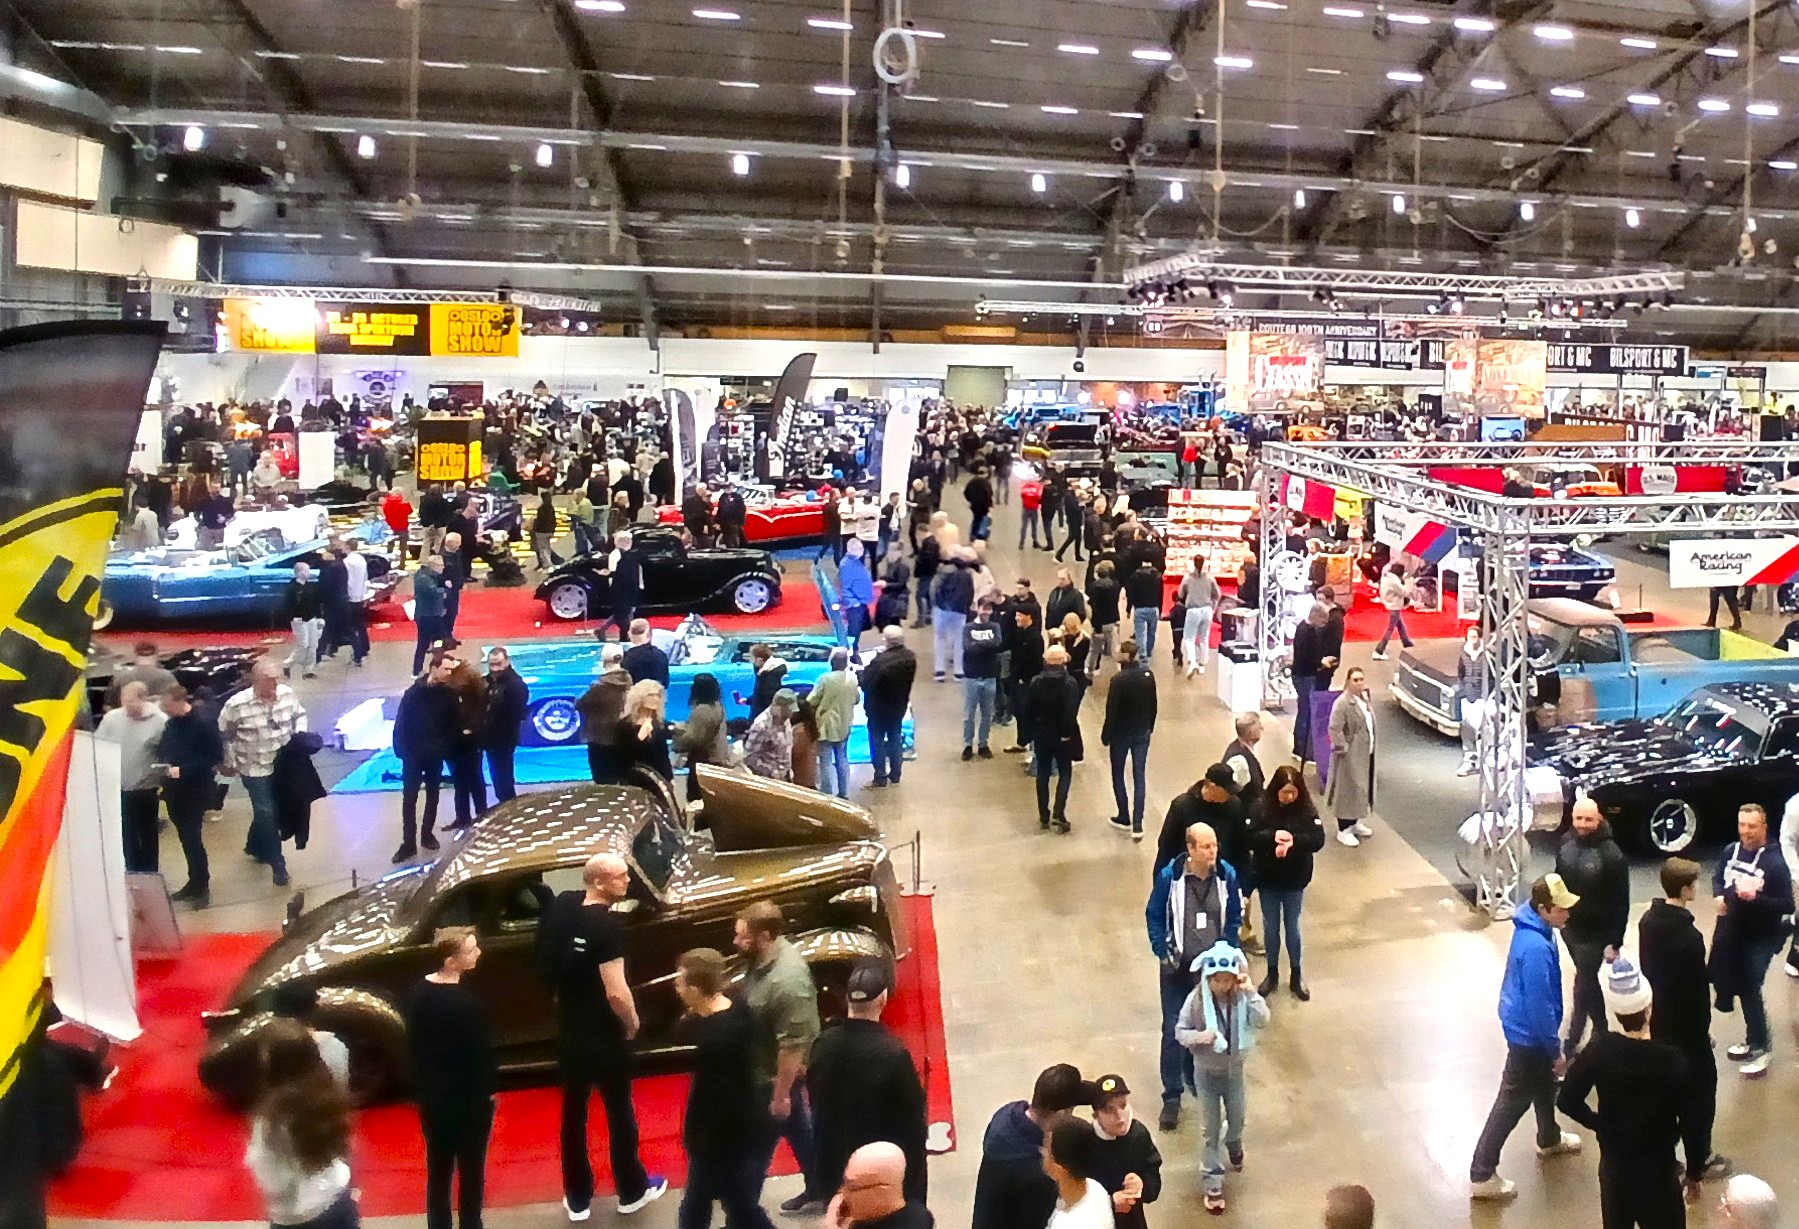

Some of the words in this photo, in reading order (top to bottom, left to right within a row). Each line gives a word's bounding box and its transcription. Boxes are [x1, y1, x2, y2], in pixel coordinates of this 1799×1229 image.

[448, 335, 502, 352] SHOW
[1567, 347, 1575, 366] &
[1576, 347, 1592, 367] MC
[1609, 347, 1652, 367] BILSPORT
[1653, 349, 1660, 368] &
[1662, 349, 1678, 368] MC
[768, 395, 796, 461] Indian
[421, 453, 465, 466] MOTOR
[419, 466, 465, 480] SHOW
[1690, 551, 1752, 564] American
[1699, 559, 1743, 575] Racing
